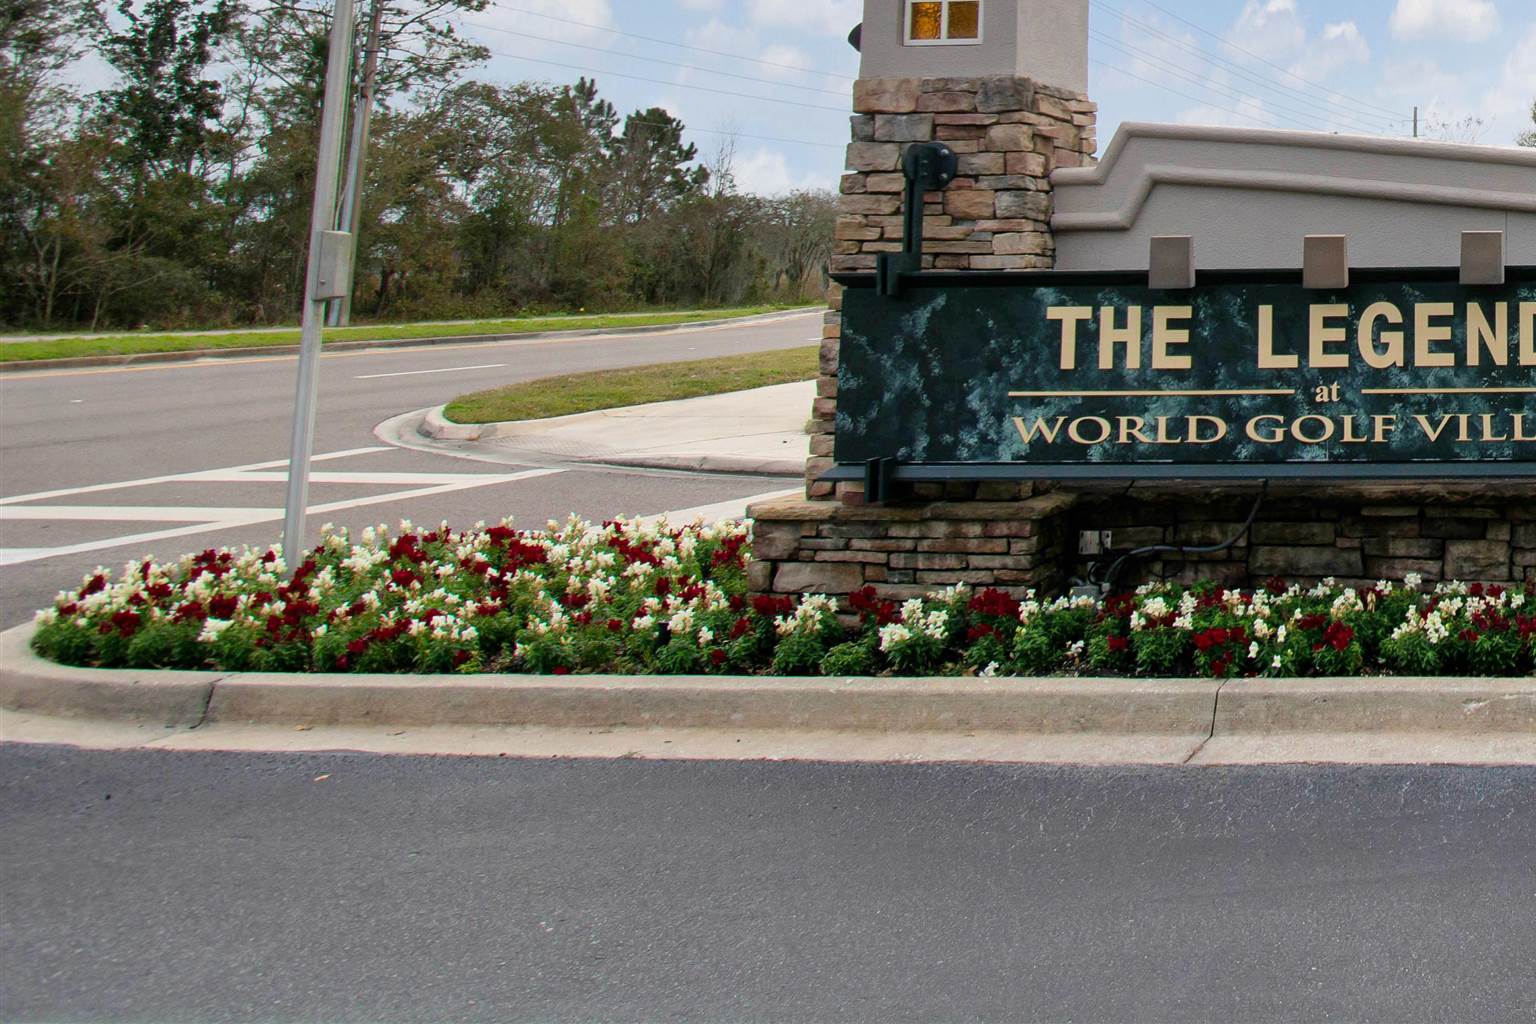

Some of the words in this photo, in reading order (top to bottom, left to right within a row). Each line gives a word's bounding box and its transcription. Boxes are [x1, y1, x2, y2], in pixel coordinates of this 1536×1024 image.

[1046, 305, 1192, 370] THE
[1314, 382, 1341, 403] at
[1012, 415, 1227, 445] WORLD
[1244, 414, 1396, 443] GOLF
